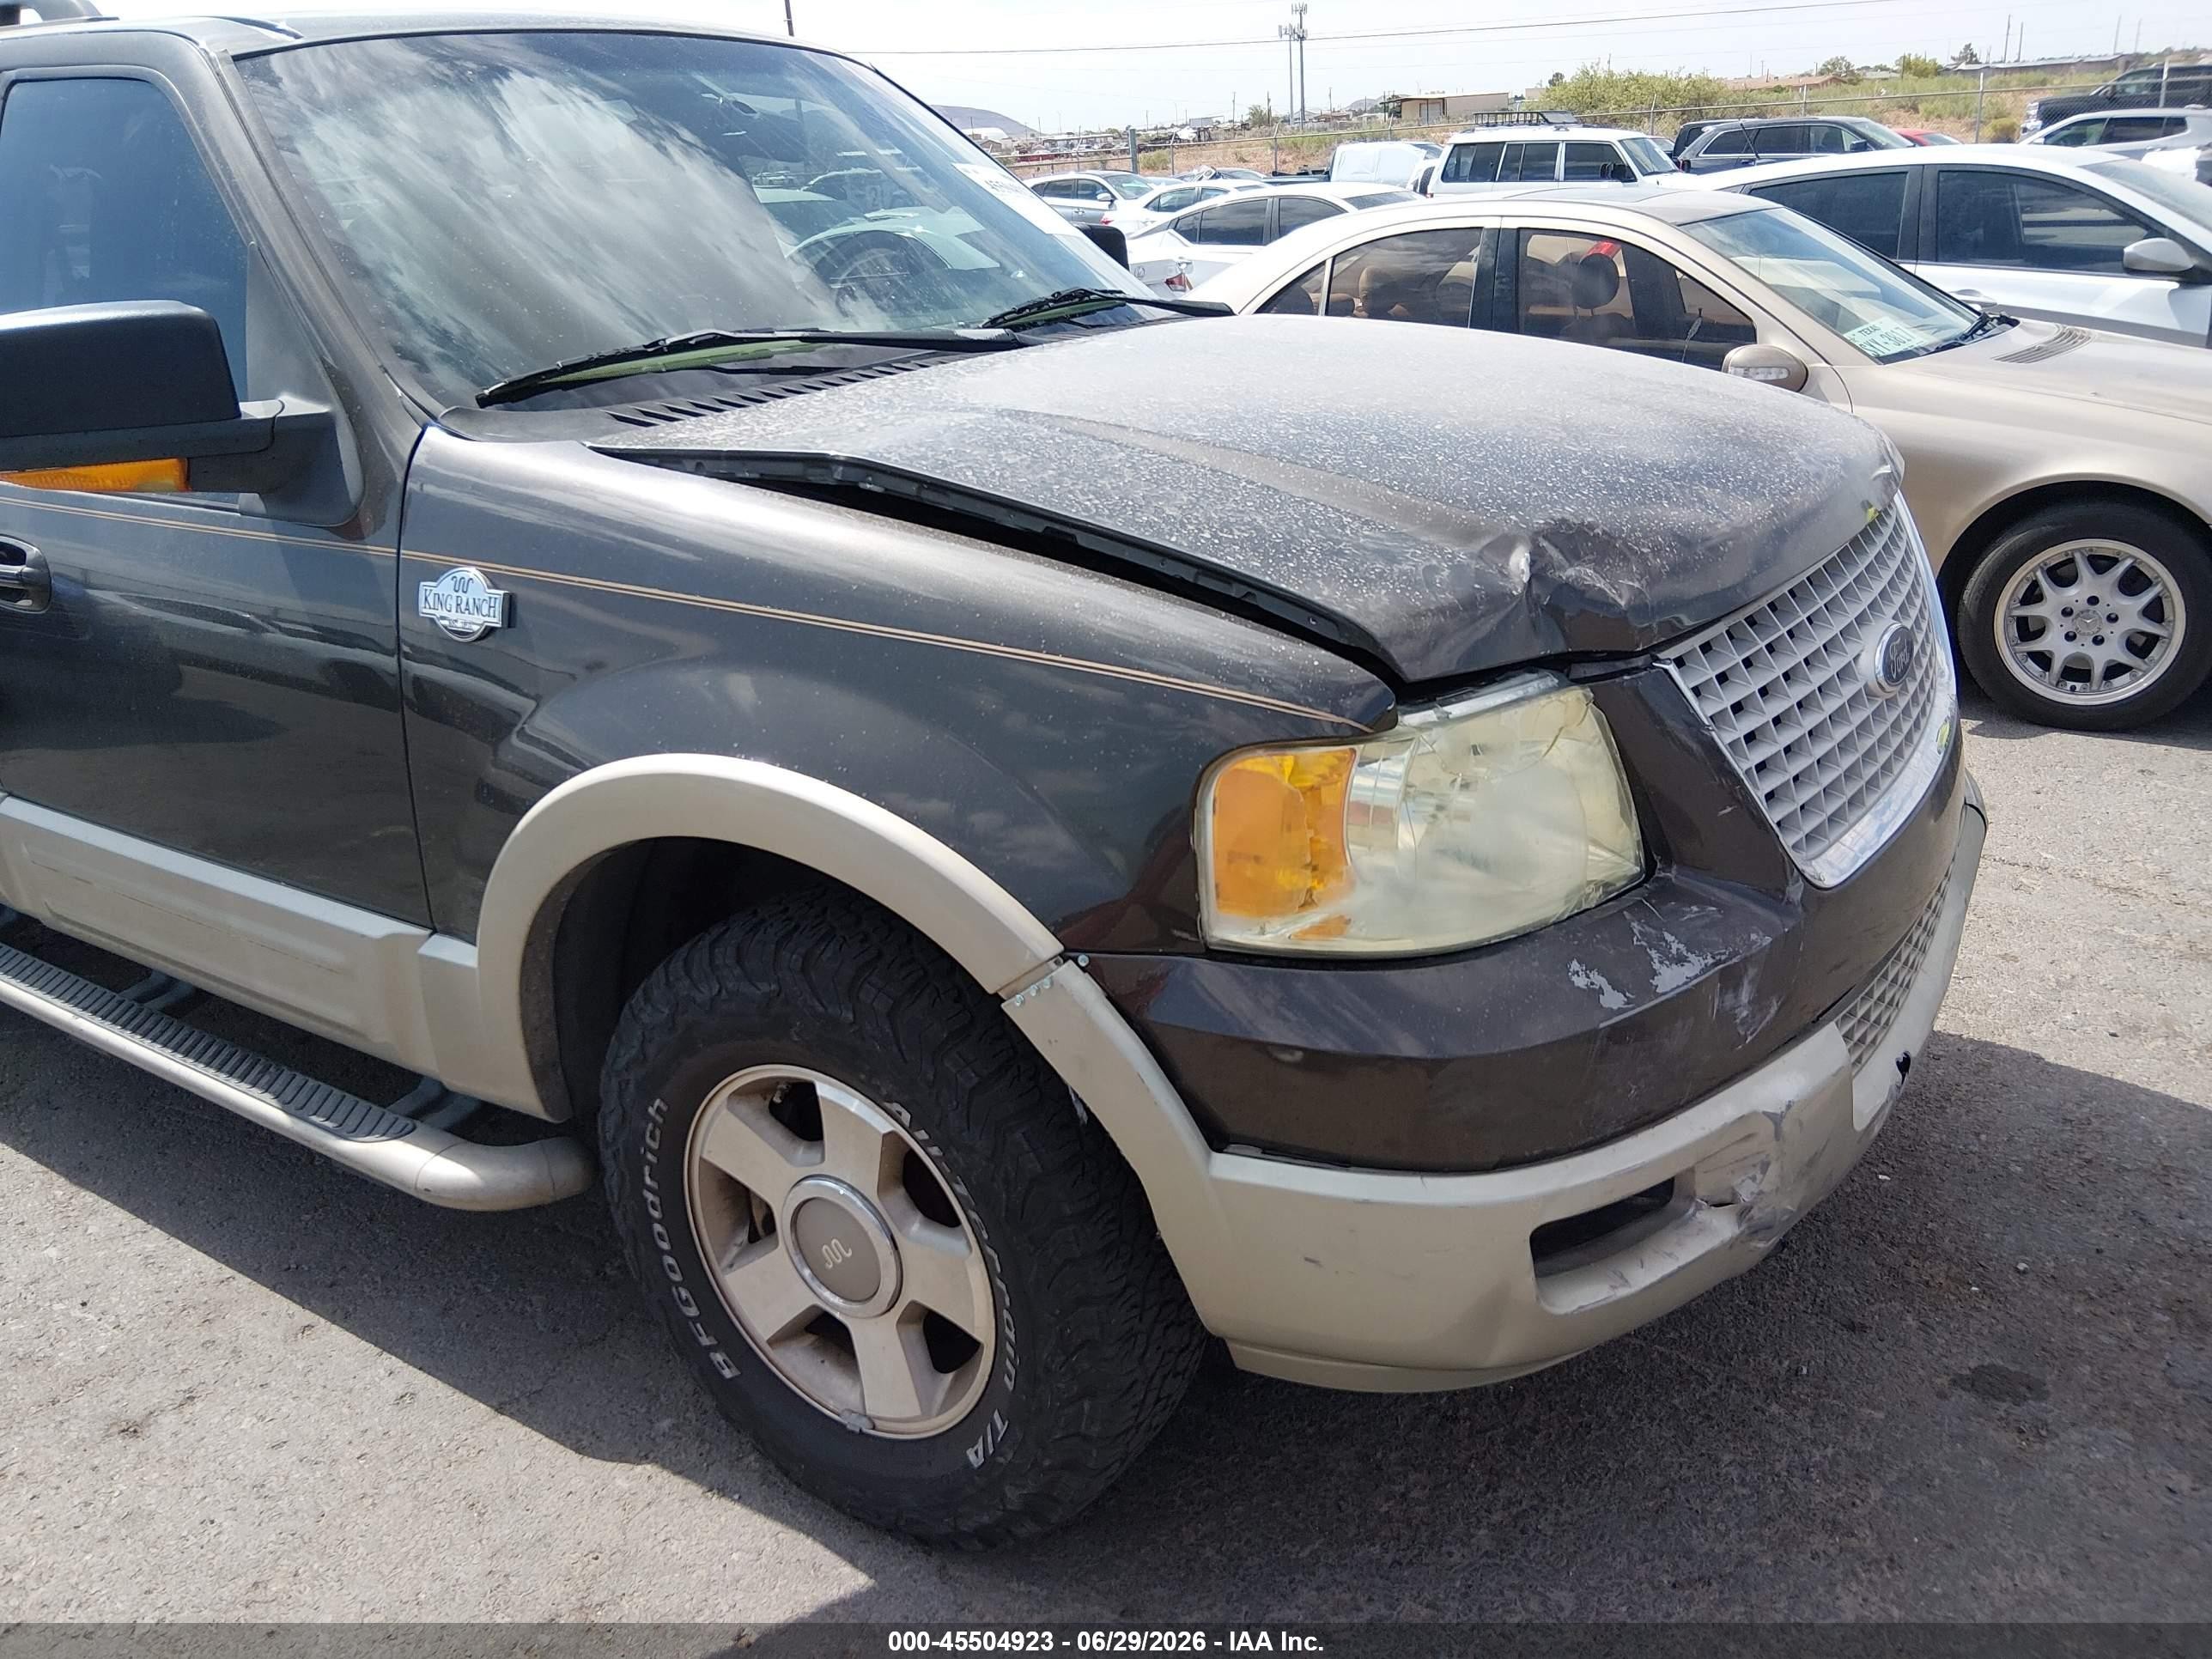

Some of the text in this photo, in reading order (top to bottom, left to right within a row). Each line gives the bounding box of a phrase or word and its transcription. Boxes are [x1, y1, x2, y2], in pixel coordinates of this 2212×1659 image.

[1857, 324, 1881, 337] TEXAS
[423, 588, 498, 619] KING RANCH
[1888, 637, 1911, 680] Ford
[639, 1097, 742, 1380] BFGoodrich
[965, 1408, 1010, 1470] T/A
